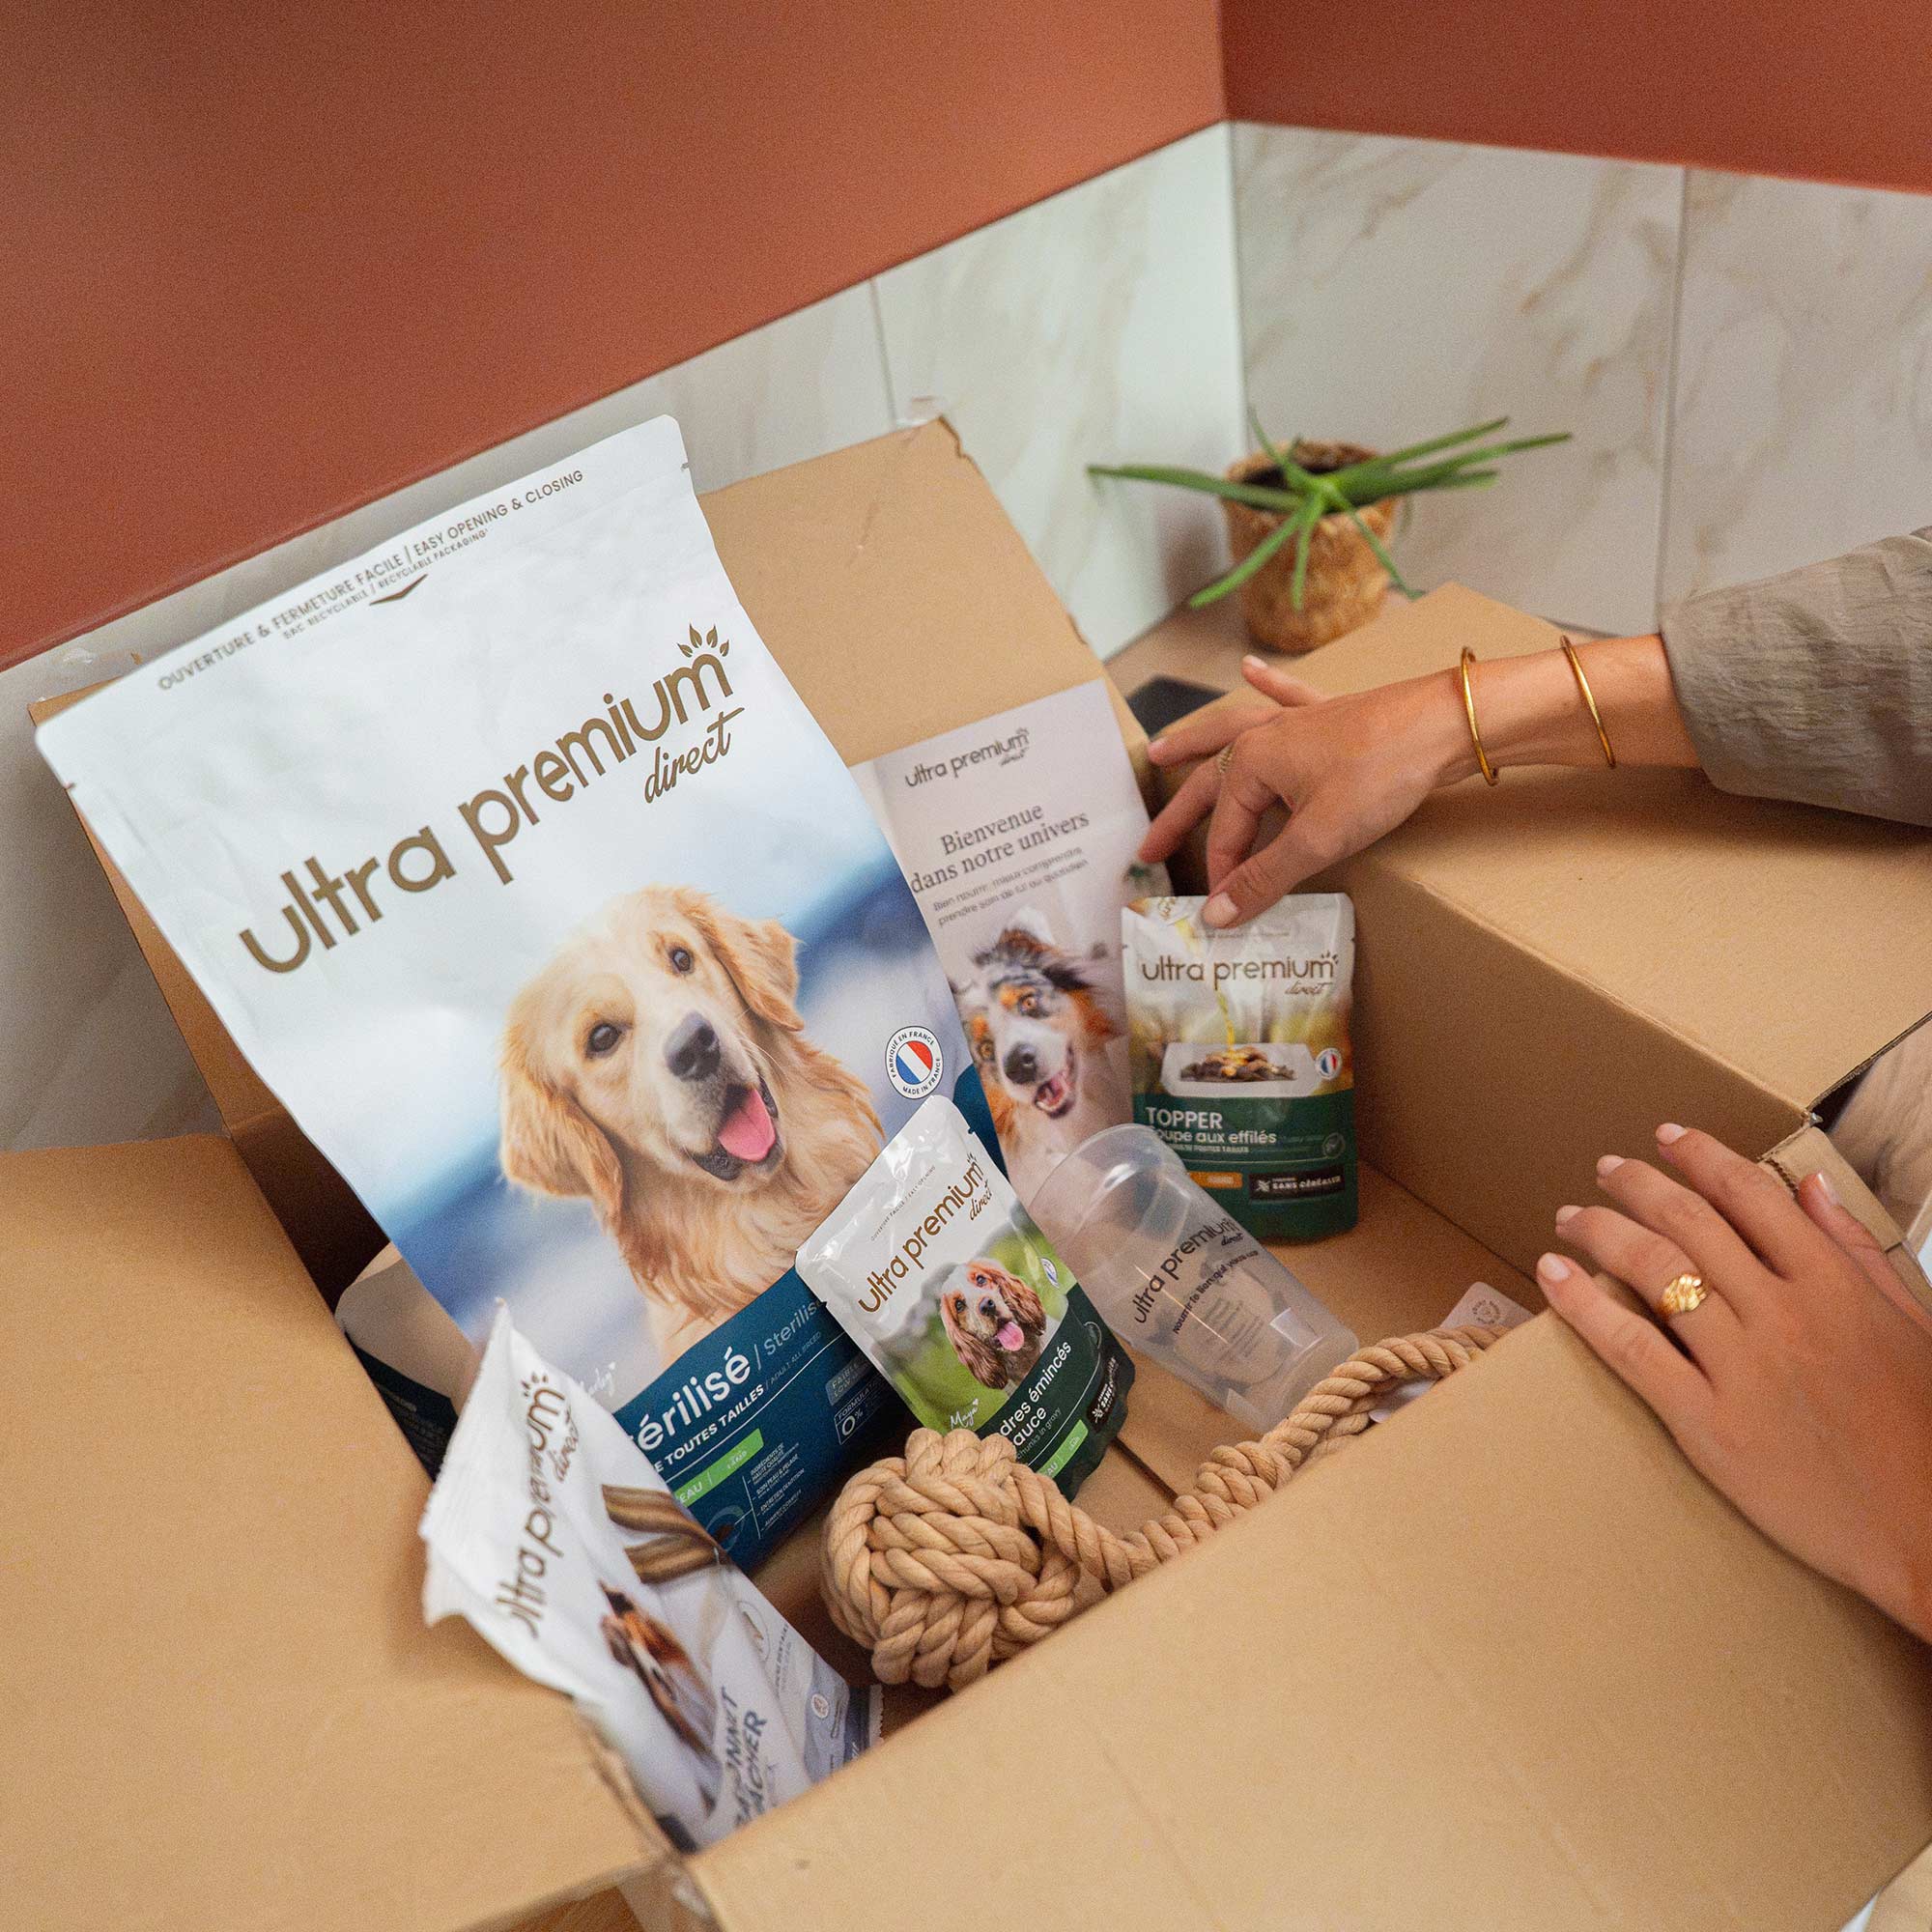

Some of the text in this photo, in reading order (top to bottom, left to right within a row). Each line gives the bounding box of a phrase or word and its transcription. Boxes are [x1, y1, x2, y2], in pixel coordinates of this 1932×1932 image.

[157, 630, 256, 692] OUVERTURE
[258, 623, 270, 638] &
[272, 578, 355, 630] FERMETURE
[355, 553, 403, 586] FACILE
[413, 530, 445, 557] EASY
[446, 502, 509, 542] OPENING
[511, 497, 525, 511] &
[525, 469, 584, 505] CLOSING
[644, 707, 746, 804] direct
[905, 731, 1030, 787] ultra premium
[239, 653, 734, 974] ultra premium
[940, 805, 1044, 856] Bienvenue
[910, 812, 1090, 894] dans notre univers
[1142, 954, 1334, 991] ultra premium
[898, 1033, 908, 1041] EN
[909, 1031, 934, 1045] FRANCE
[902, 1086, 920, 1095] MADE
[928, 1059, 941, 1086] FRANCE
[1145, 1107, 1223, 1129] TOPPER
[1157, 1128, 1193, 1143] oupe
[1196, 1132, 1225, 1144] aux
[1228, 1129, 1277, 1145] effilés
[969, 1179, 993, 1222] direct
[858, 1161, 985, 1314] ultra premium
[1134, 1219, 1240, 1323] ultra premium
[637, 1346, 751, 1451] érilisé
[753, 1344, 761, 1371] /
[1000, 1341, 1072, 1436] dres émincés
[665, 1423, 718, 1465] TOUTES
[719, 1384, 764, 1427] TAILLES
[1012, 1406, 1047, 1446] auce
[1017, 1406, 1062, 1459] chunks in gravy
